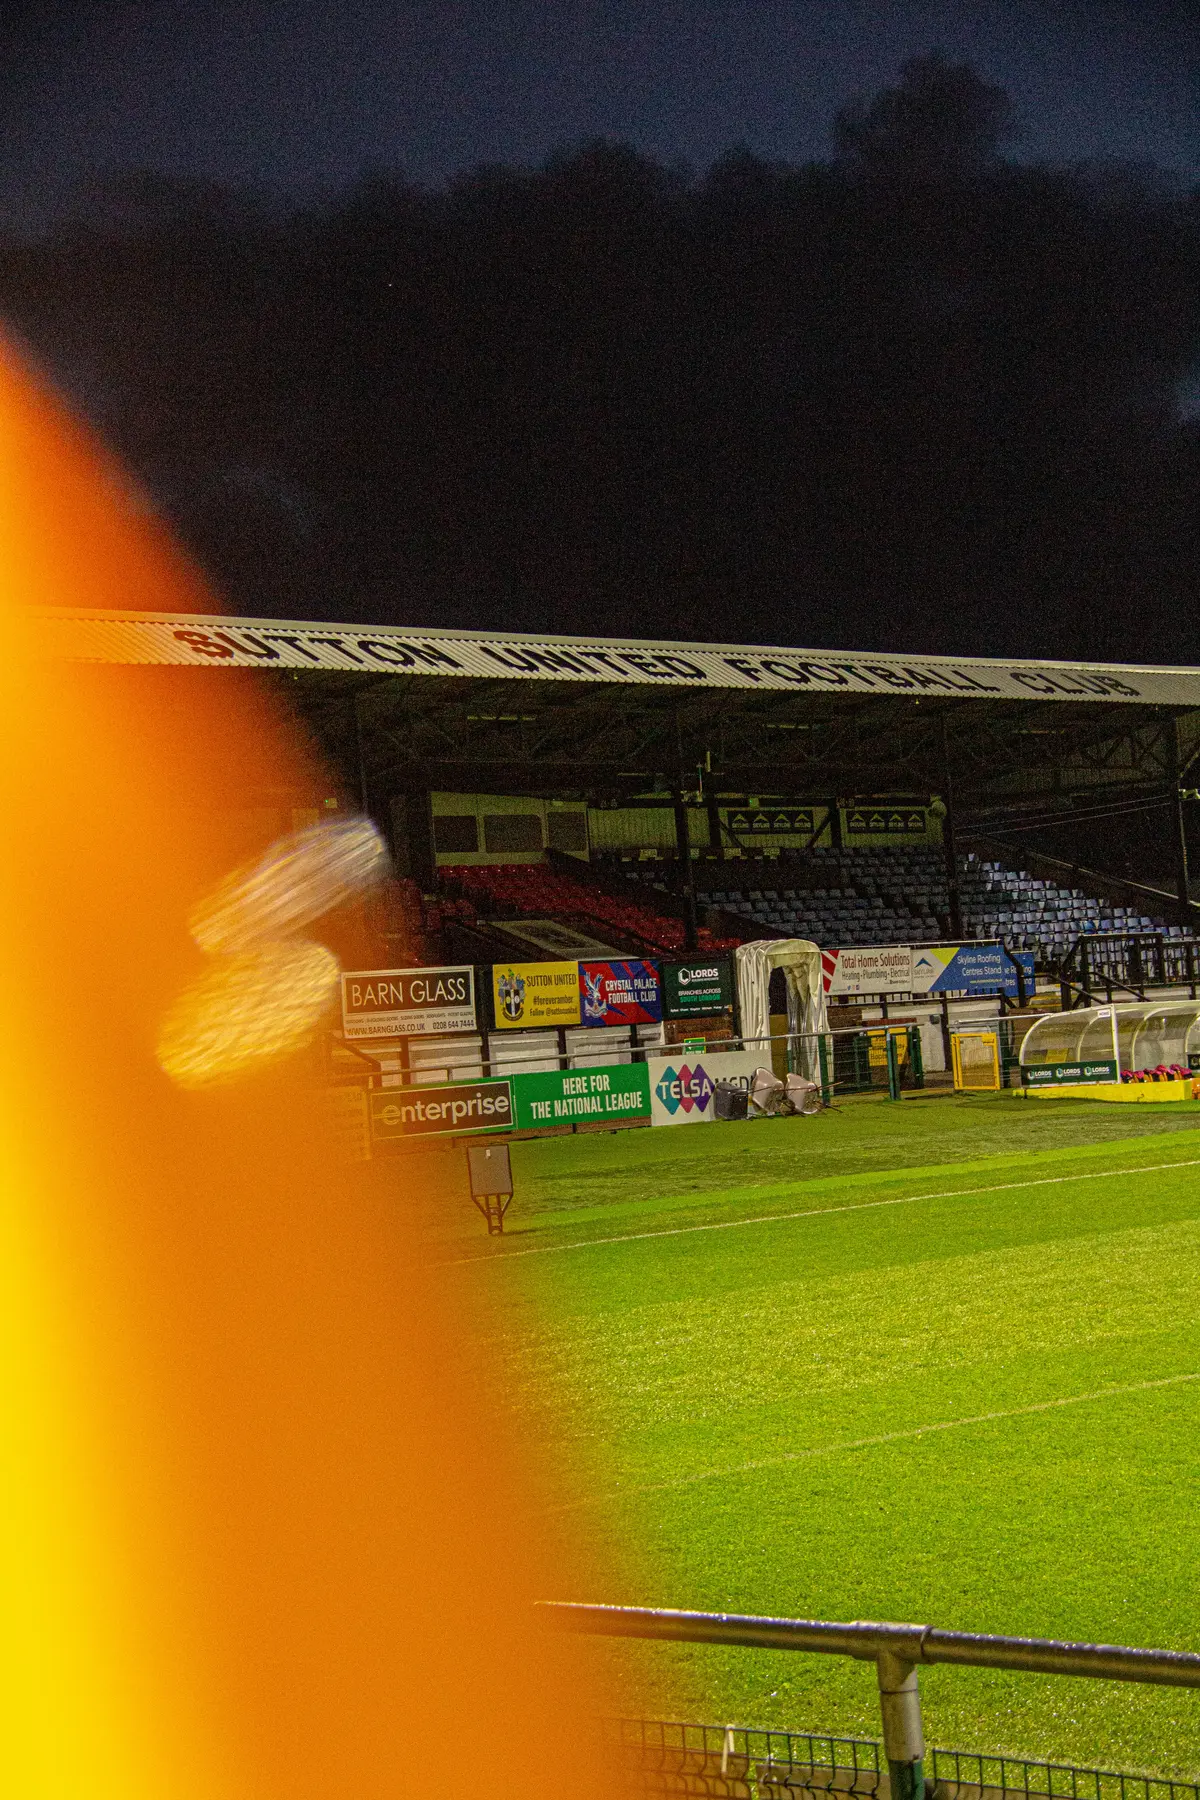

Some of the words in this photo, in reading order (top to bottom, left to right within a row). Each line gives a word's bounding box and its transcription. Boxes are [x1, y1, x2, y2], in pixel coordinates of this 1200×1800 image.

[173, 631, 464, 669] SUTTON
[480, 646, 707, 680] UNITED
[724, 658, 1000, 692] FOOTBALL
[1011, 672, 1142, 697] CLUB
[840, 953, 857, 969] Total
[858, 954, 878, 968] Home
[880, 952, 911, 967] Solutions
[957, 954, 976, 965] Skyline
[977, 953, 1001, 965] Roofing
[691, 968, 719, 979] LORDS
[842, 971, 860, 983] Heating
[863, 969, 888, 981] Plumbing
[890, 967, 910, 978] Electrical
[962, 967, 983, 977] Centres
[984, 965, 1002, 975] Stand
[526, 975, 553, 987] SUTTON
[554, 973, 577, 986] UNITED
[605, 979, 633, 991] CRYSTAL
[634, 978, 657, 989] PALACE
[352, 982, 404, 1007] BARN
[410, 978, 466, 1003] GLASS
[608, 992, 639, 1004] FOOTBALL
[640, 990, 657, 1002] CLUB
[703, 987, 721, 995] ACROSS
[533, 995, 574, 1006] #foreveramber
[529, 1008, 544, 1017] Follow
[346, 1022, 426, 1036] WWW.BARNGLASS.CO.UK
[432, 1021, 447, 1030] 0208
[447, 1020, 459, 1029] 644
[460, 1019, 474, 1028] 7444
[562, 1077, 588, 1096] HERE
[590, 1074, 611, 1092] FOR
[658, 1078, 713, 1100] TELSA
[381, 1092, 509, 1125] enterprise
[530, 1100, 552, 1120] THE
[554, 1096, 604, 1117] NATIONAL
[605, 1091, 643, 1113] LEAGUE
